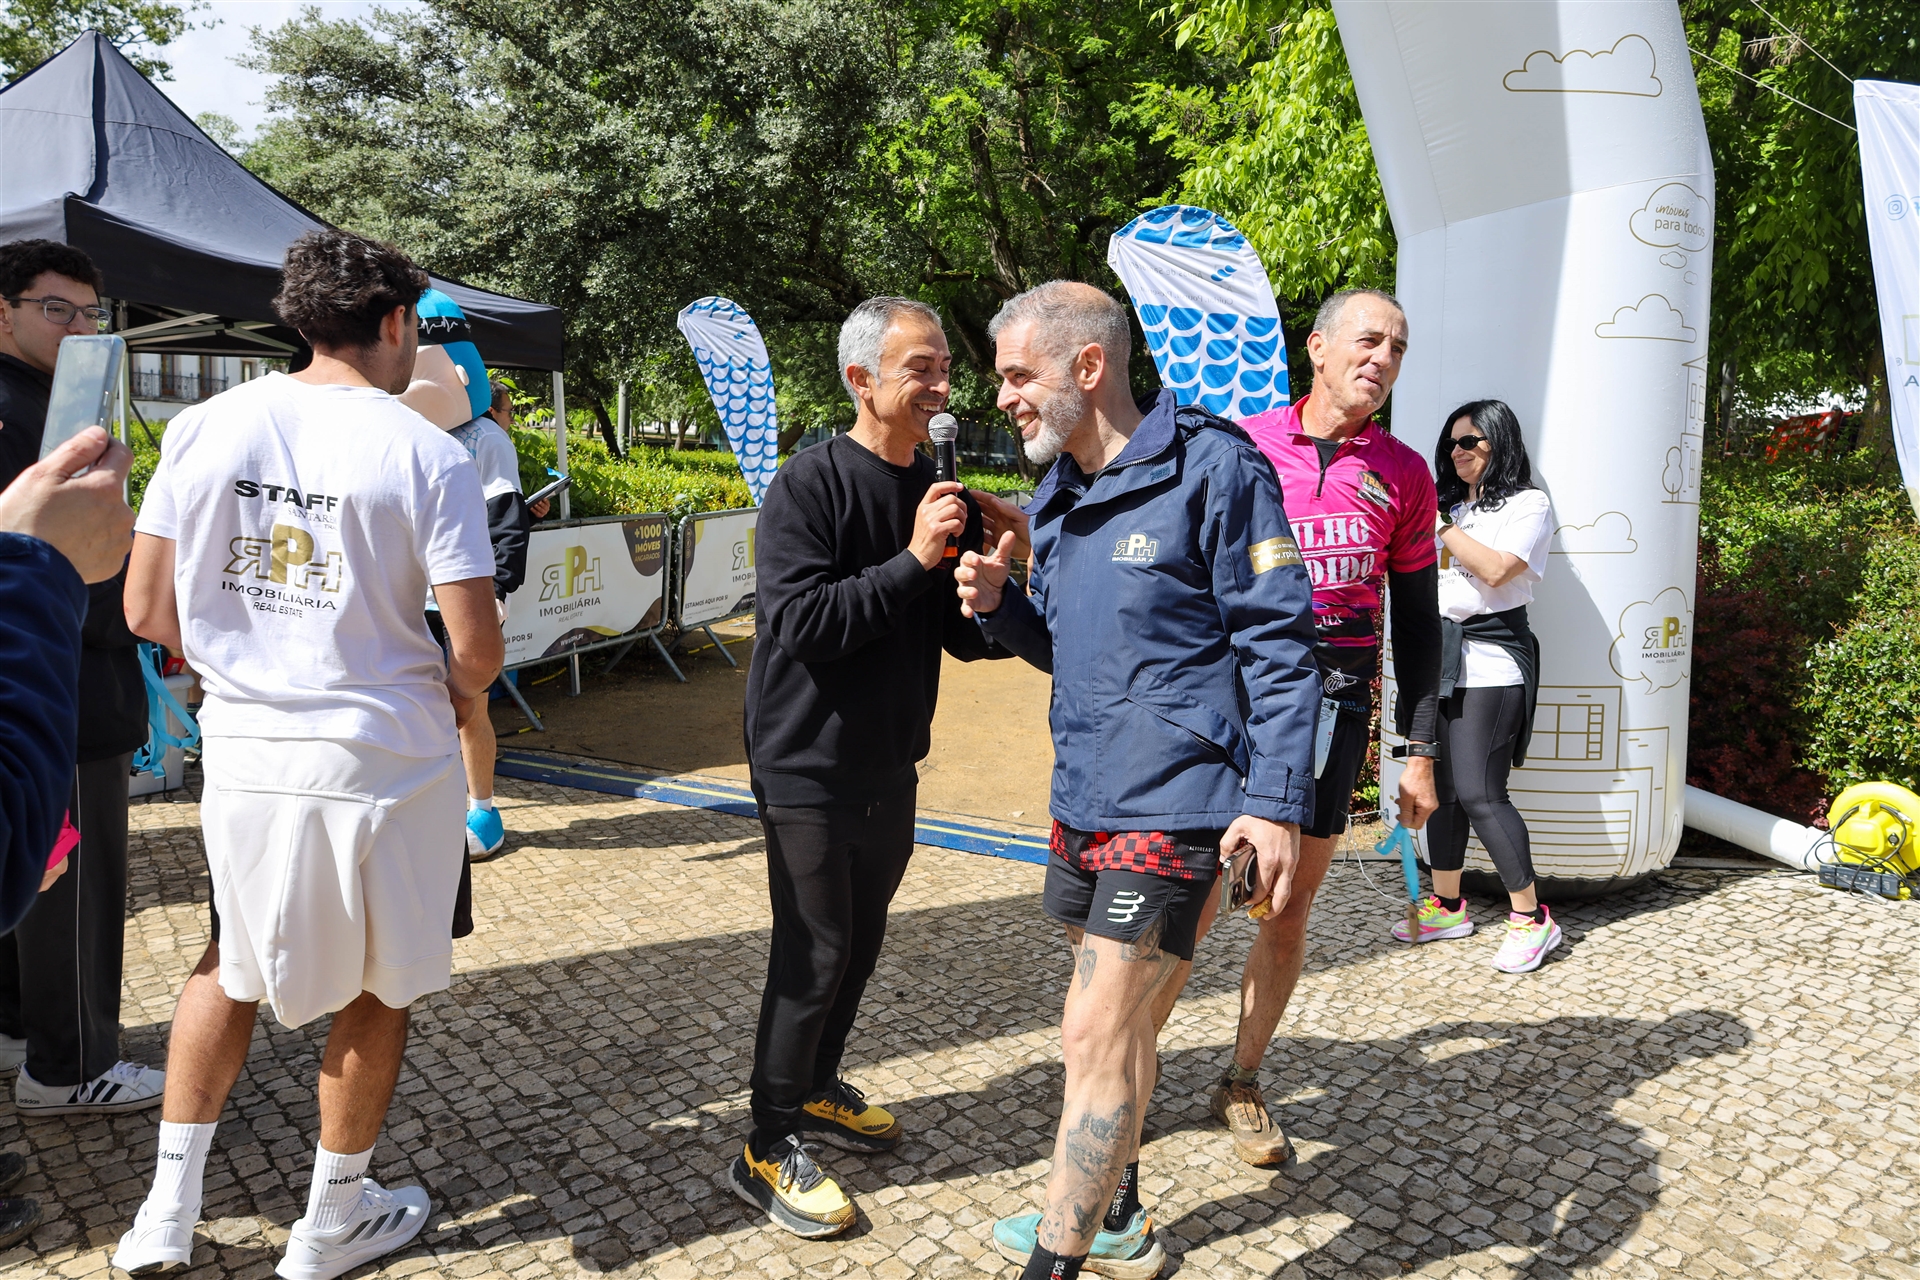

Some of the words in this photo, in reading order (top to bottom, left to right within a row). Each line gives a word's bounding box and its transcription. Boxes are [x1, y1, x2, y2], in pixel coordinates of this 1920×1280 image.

[1654, 219, 1681, 231] para
[1683, 220, 1706, 238] todos
[234, 480, 339, 512] STAFF
[634, 522, 662, 540] +1000
[634, 540, 661, 553] IMÓVEIS
[222, 581, 337, 610] IMOBILIÁRIA
[253, 601, 277, 613] REAL
[278, 606, 303, 618] ESTATE
[539, 596, 602, 618] IMOBILIÁRIA
[512, 634, 526, 642] POR
[527, 632, 533, 640] SI
[1641, 650, 1686, 659] IMOBILIÁRIA
